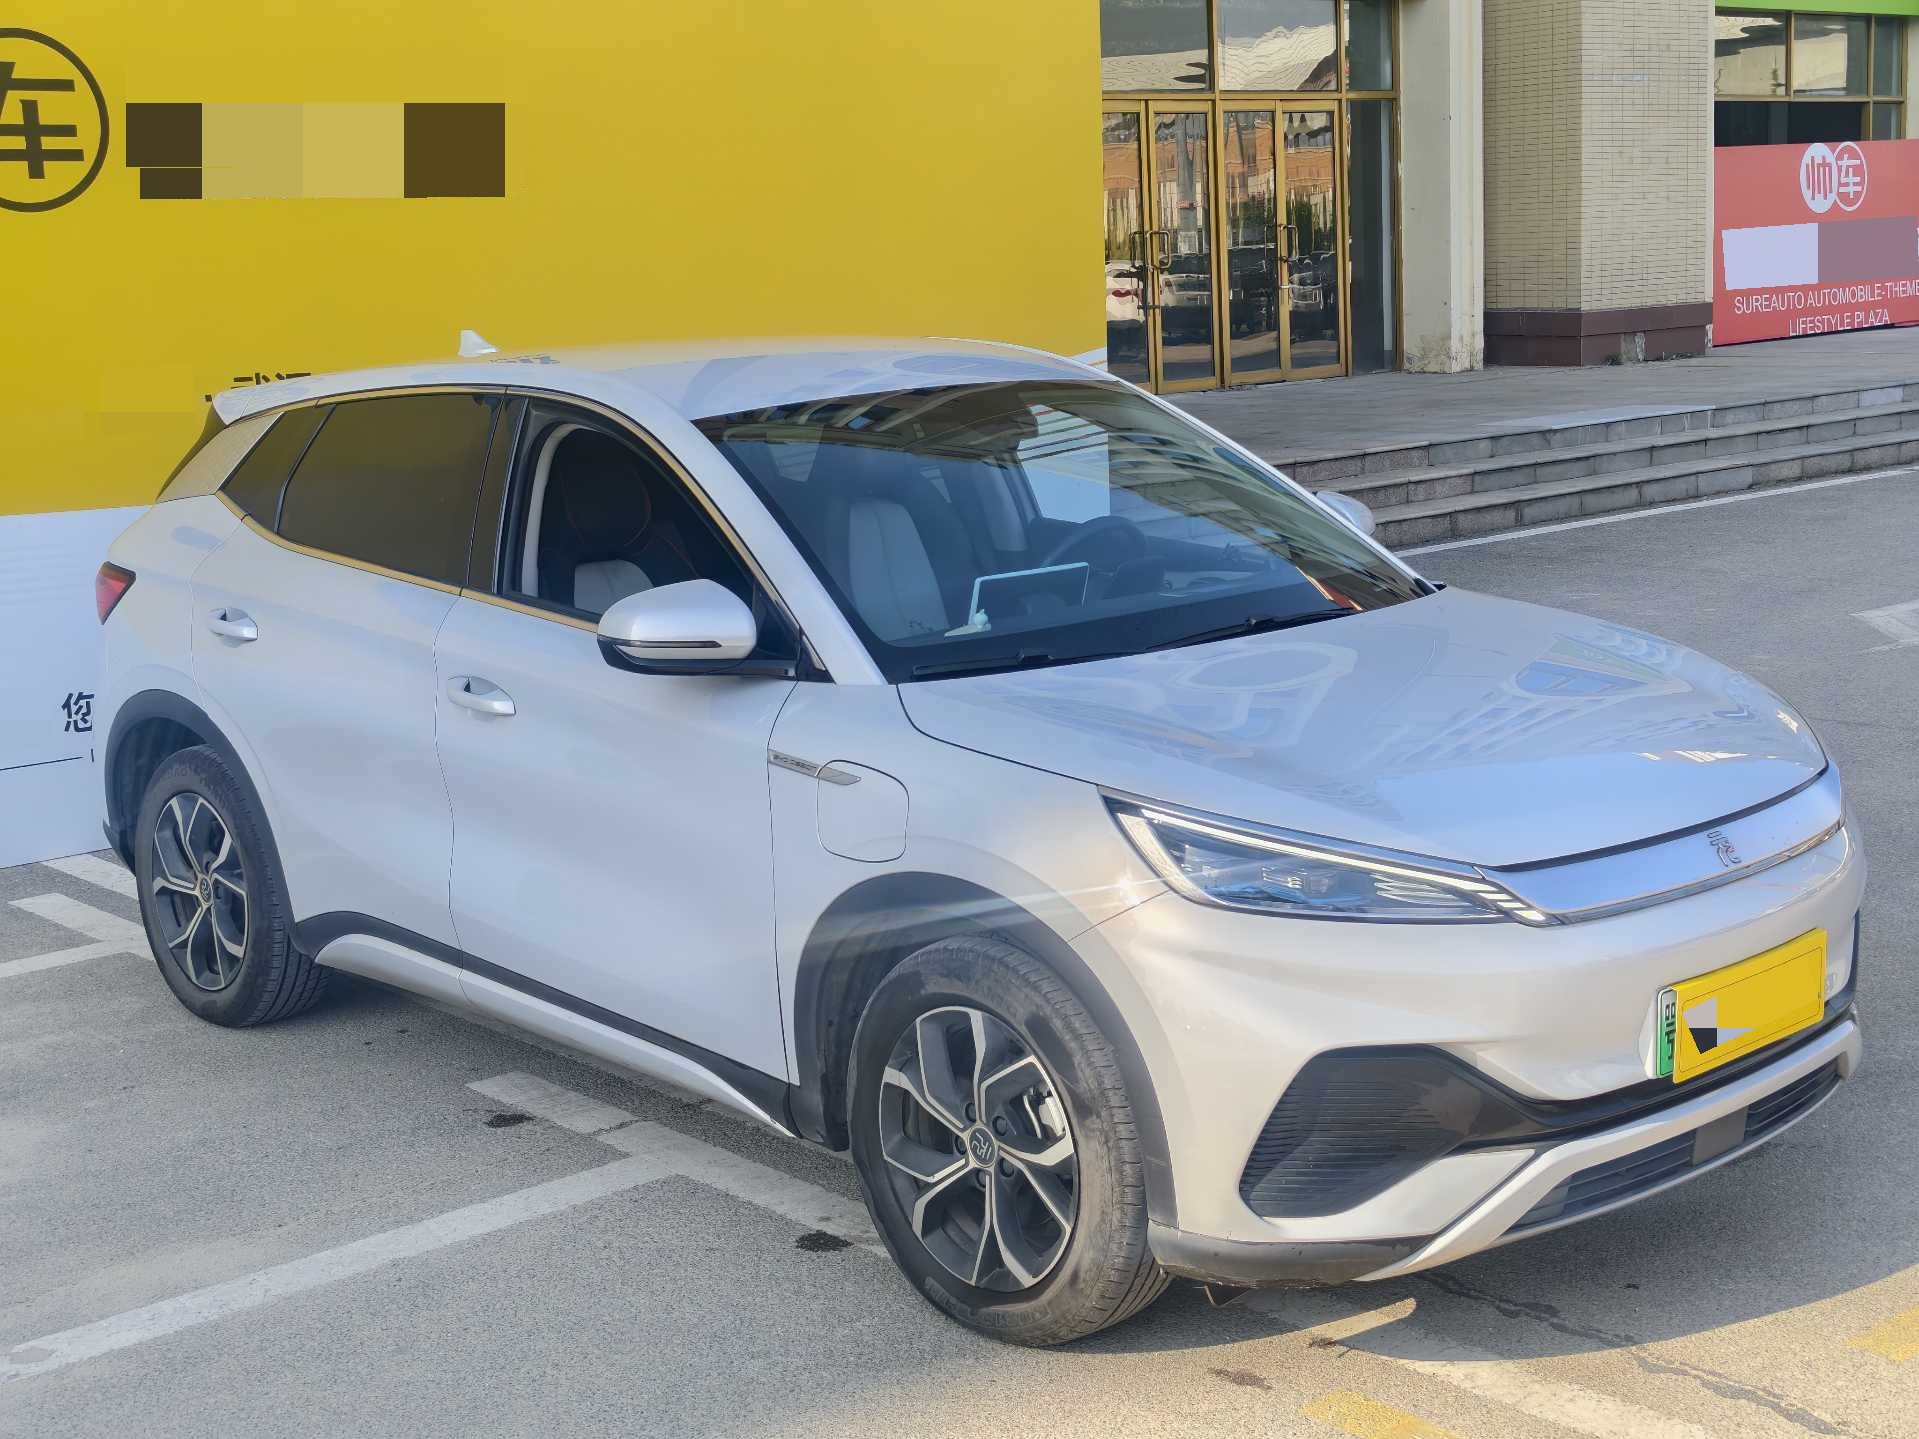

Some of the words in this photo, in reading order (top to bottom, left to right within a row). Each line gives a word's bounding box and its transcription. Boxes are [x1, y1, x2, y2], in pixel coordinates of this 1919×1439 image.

[1734, 291, 1805, 314] SUREAUTO
[1789, 312, 1852, 336] LIFESTYLE
[1854, 308, 1890, 328] PLAZA
